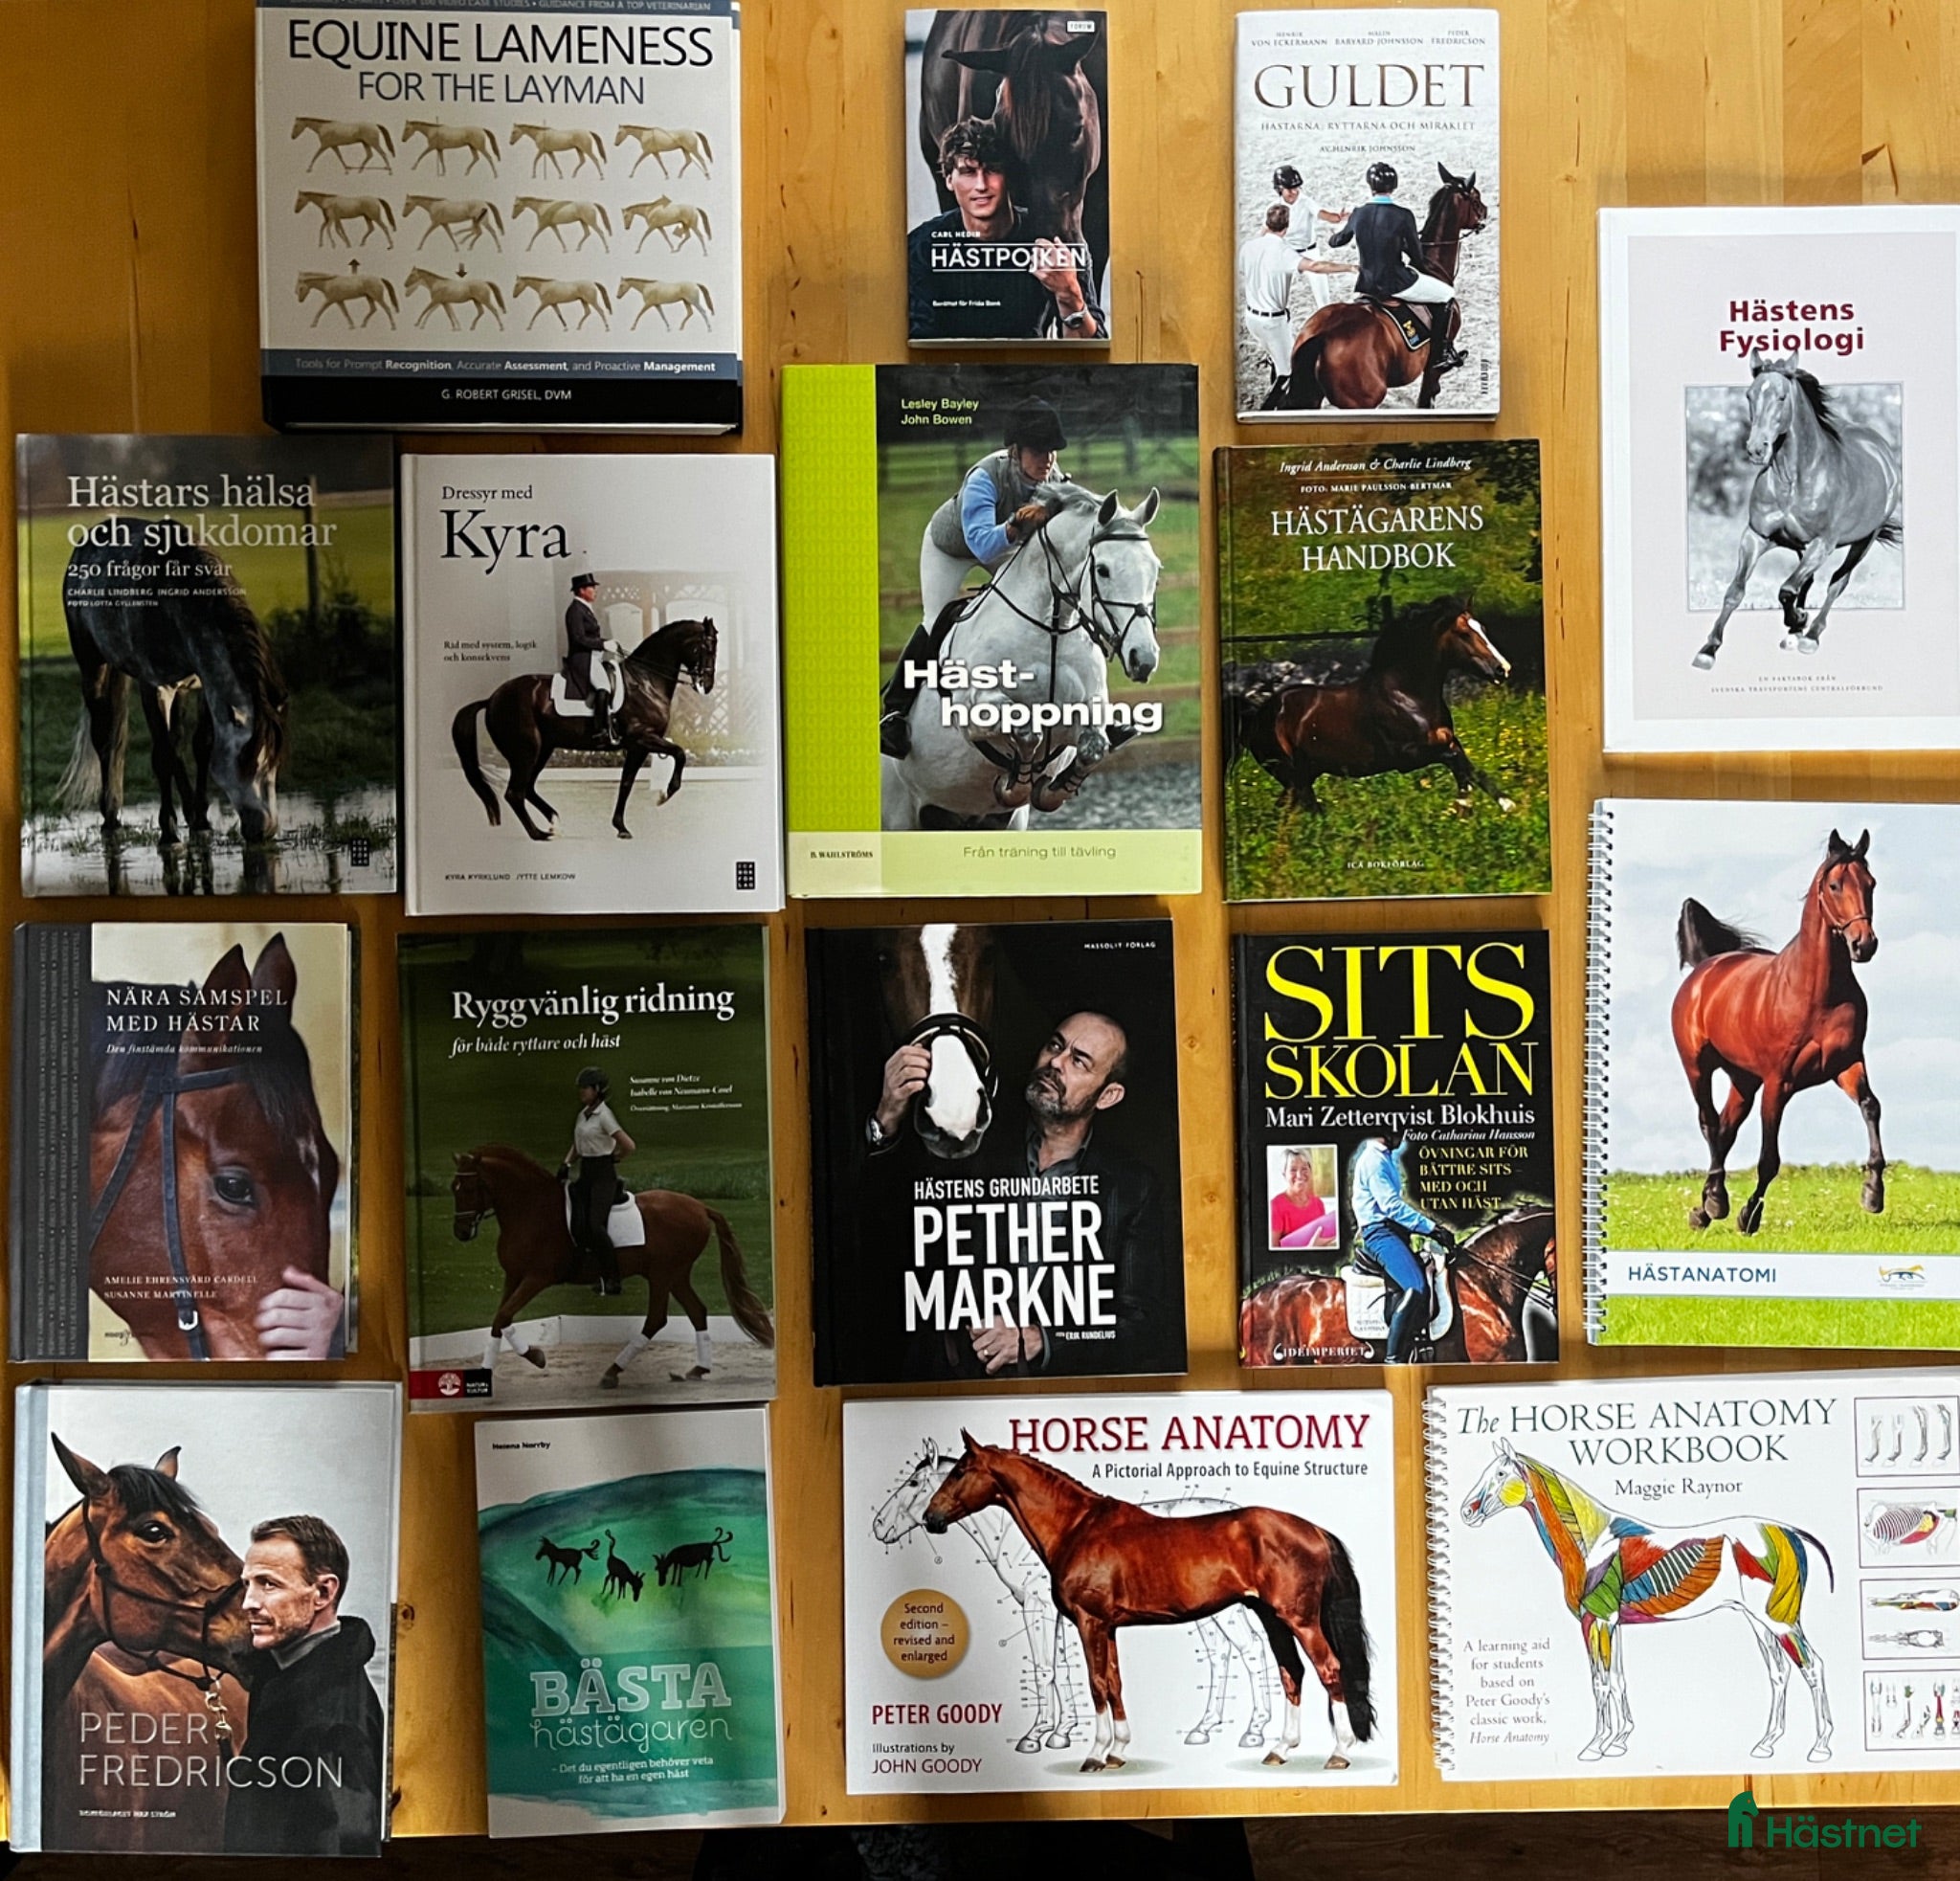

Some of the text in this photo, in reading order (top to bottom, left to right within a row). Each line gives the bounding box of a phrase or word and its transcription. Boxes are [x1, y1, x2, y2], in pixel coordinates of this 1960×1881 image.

[289, 19, 714, 69] EQUINE LAMENESS
[359, 72, 644, 104] FOR THE LAYMAN
[1254, 63, 1485, 109] GULDET
[930, 241, 1086, 273] HÄSTPOJKEN
[1729, 299, 1855, 323] Hästens
[1720, 326, 1864, 358] Fysiologi
[296, 358, 323, 369] Tools
[325, 358, 341, 369] for
[344, 359, 383, 370] Prompt
[457, 360, 501, 370] Accurate
[504, 360, 569, 371] Assessment,
[571, 361, 591, 370] and
[594, 361, 641, 371] Proactive
[643, 362, 716, 373] Management
[456, 389, 499, 399] ROBERT
[501, 389, 542, 401] GRISEL,
[545, 390, 572, 400] DVM
[902, 398, 980, 412] Lesley Bayley
[901, 414, 972, 425] John Bowen
[1280, 456, 1472, 476] Ingrid Andersson & Charlie Lindberg
[67, 474, 316, 508] Hästars hälsa
[442, 484, 534, 504] Dressyr med
[1270, 504, 1484, 536] HÄSTÄGARENS
[67, 513, 338, 556] och sjukdomar
[439, 509, 572, 575] Kyra
[1302, 543, 1457, 572] HANDBOK
[67, 559, 233, 580] 250 frågor får svar
[67, 588, 248, 597] CHARLIE LINDBERG INGRID ANDERSSON
[443, 640, 538, 652] Rid med system, logik
[443, 653, 511, 662] och konsekvens
[902, 660, 1036, 690] Häst-
[941, 696, 1164, 734] hoppning
[963, 843, 1116, 862] Från träning till tävling
[106, 986, 288, 1006] NÄRA SAMSPEL
[1264, 942, 1535, 1043] SITS
[452, 982, 735, 1029] Ryggvänlig ridning
[106, 1012, 261, 1032] MED HÄSTAR
[448, 1032, 622, 1058] för både ryttare och häst
[1264, 1042, 1539, 1100] SKOLAN
[1265, 1103, 1536, 1133] Mari Zetterqvist Blokhuis
[1402, 1128, 1536, 1141] Foto Catharina Hansson
[1418, 1143, 1528, 1159] ÖVNINGAR FÖR
[1419, 1161, 1512, 1176] BÄTTRE SITS
[914, 1175, 1100, 1200] HÄSTENS GRUNDARBETE
[1419, 1179, 1487, 1193] MED OCH
[1420, 1195, 1502, 1210] UTAN HÄST
[914, 1199, 1104, 1267] PETHER
[104, 1275, 143, 1285] AMELIE
[213, 1275, 257, 1284] CARDELL
[1628, 1263, 1776, 1283] HÄSTANATOMI
[904, 1264, 1117, 1332] MARKNE
[1457, 1398, 1838, 1435] The HORSE ANATOMY
[1009, 1415, 1370, 1453] HORSE ANATOMY
[1569, 1434, 1789, 1467] WORKBOOK
[1092, 1461, 1369, 1481] A Pictorial Approach to Equine Structure
[1615, 1477, 1743, 1501] Maggie Raynor
[903, 1602, 944, 1614] Second
[900, 1619, 939, 1630] edition
[893, 1634, 955, 1646] revised and
[1463, 1637, 1550, 1655] A learning aid
[901, 1650, 947, 1664] enlarged
[1471, 1656, 1545, 1670] for students
[529, 1656, 732, 1717] BÄSTA
[1480, 1674, 1535, 1689] based on
[1465, 1693, 1497, 1707] Peter
[872, 1703, 1003, 1725] PETER GOODY
[1469, 1711, 1548, 1726] classic work,
[80, 1712, 209, 1744] PEDER
[529, 1714, 733, 1754] hästägaren
[1469, 1731, 1549, 1746] Horse Anatomy
[872, 1742, 955, 1756] Illustrations by
[79, 1754, 343, 1788] FREDRICSON
[559, 1756, 714, 1774] Det du egentligen behöver veta
[873, 1758, 983, 1774] JOHN GOODY
[578, 1768, 689, 1784] för att ha en egen häst
